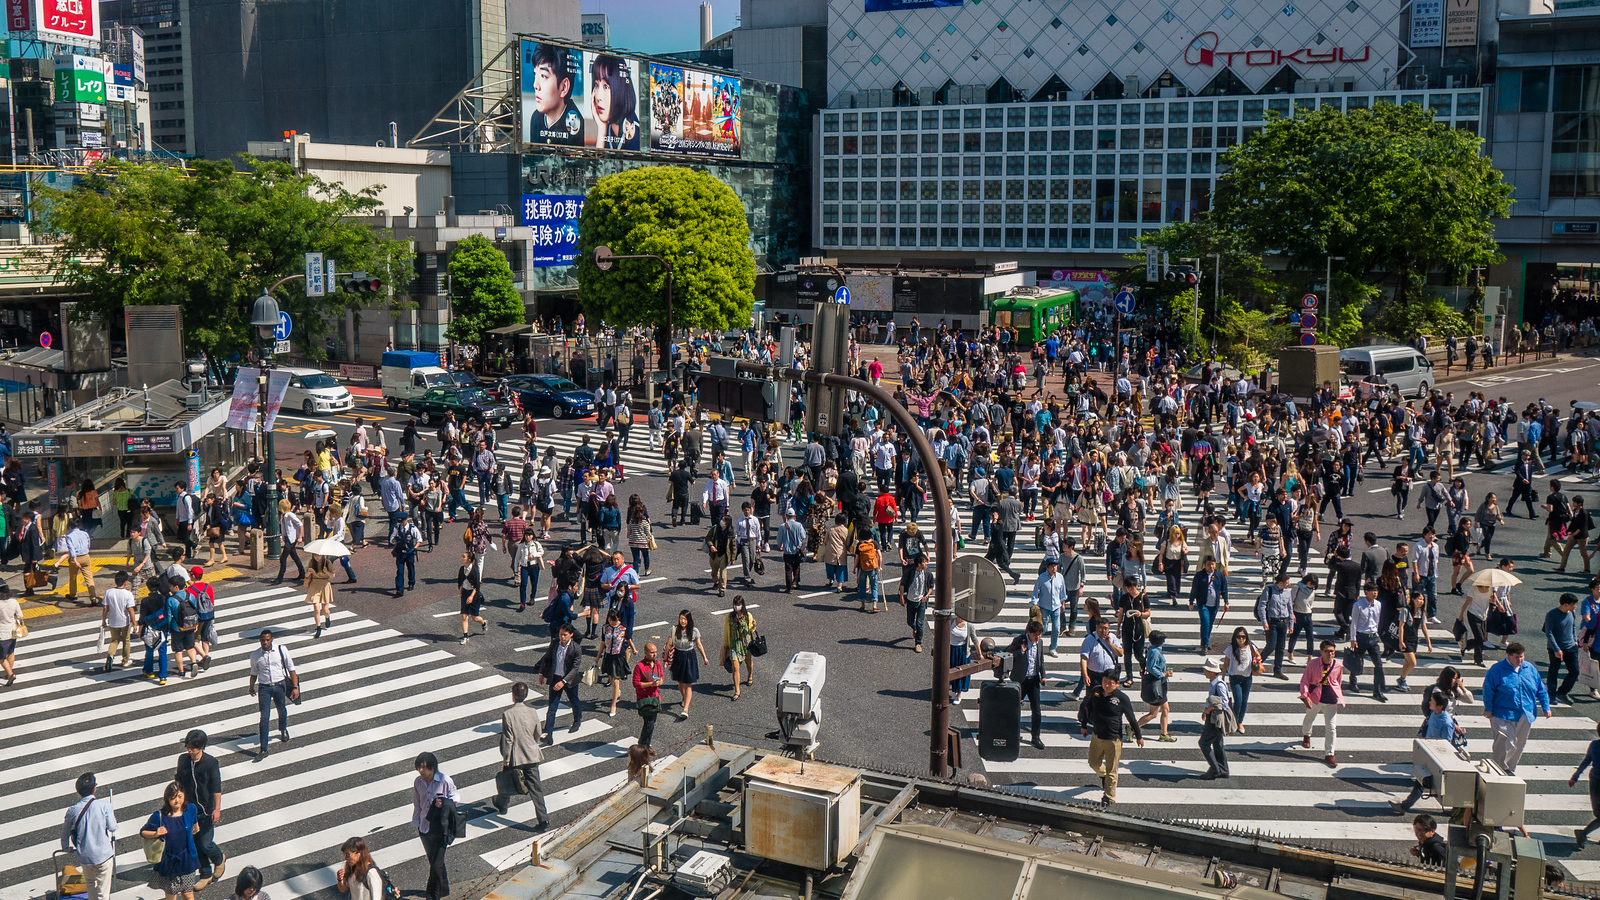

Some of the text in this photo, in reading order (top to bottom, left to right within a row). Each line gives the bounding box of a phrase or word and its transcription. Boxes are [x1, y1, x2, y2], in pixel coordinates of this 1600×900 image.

[51, 15, 86, 30] グループ
[1215, 45, 1370, 68] TOKYU
[61, 71, 70, 99] レイク
[77, 78, 102, 93] レイク
[528, 166, 550, 186] JR
[529, 225, 580, 247] 保険があ
[313, 256, 322, 293] 渋谷駅前
[17, 445, 44, 454] 渋谷駅
